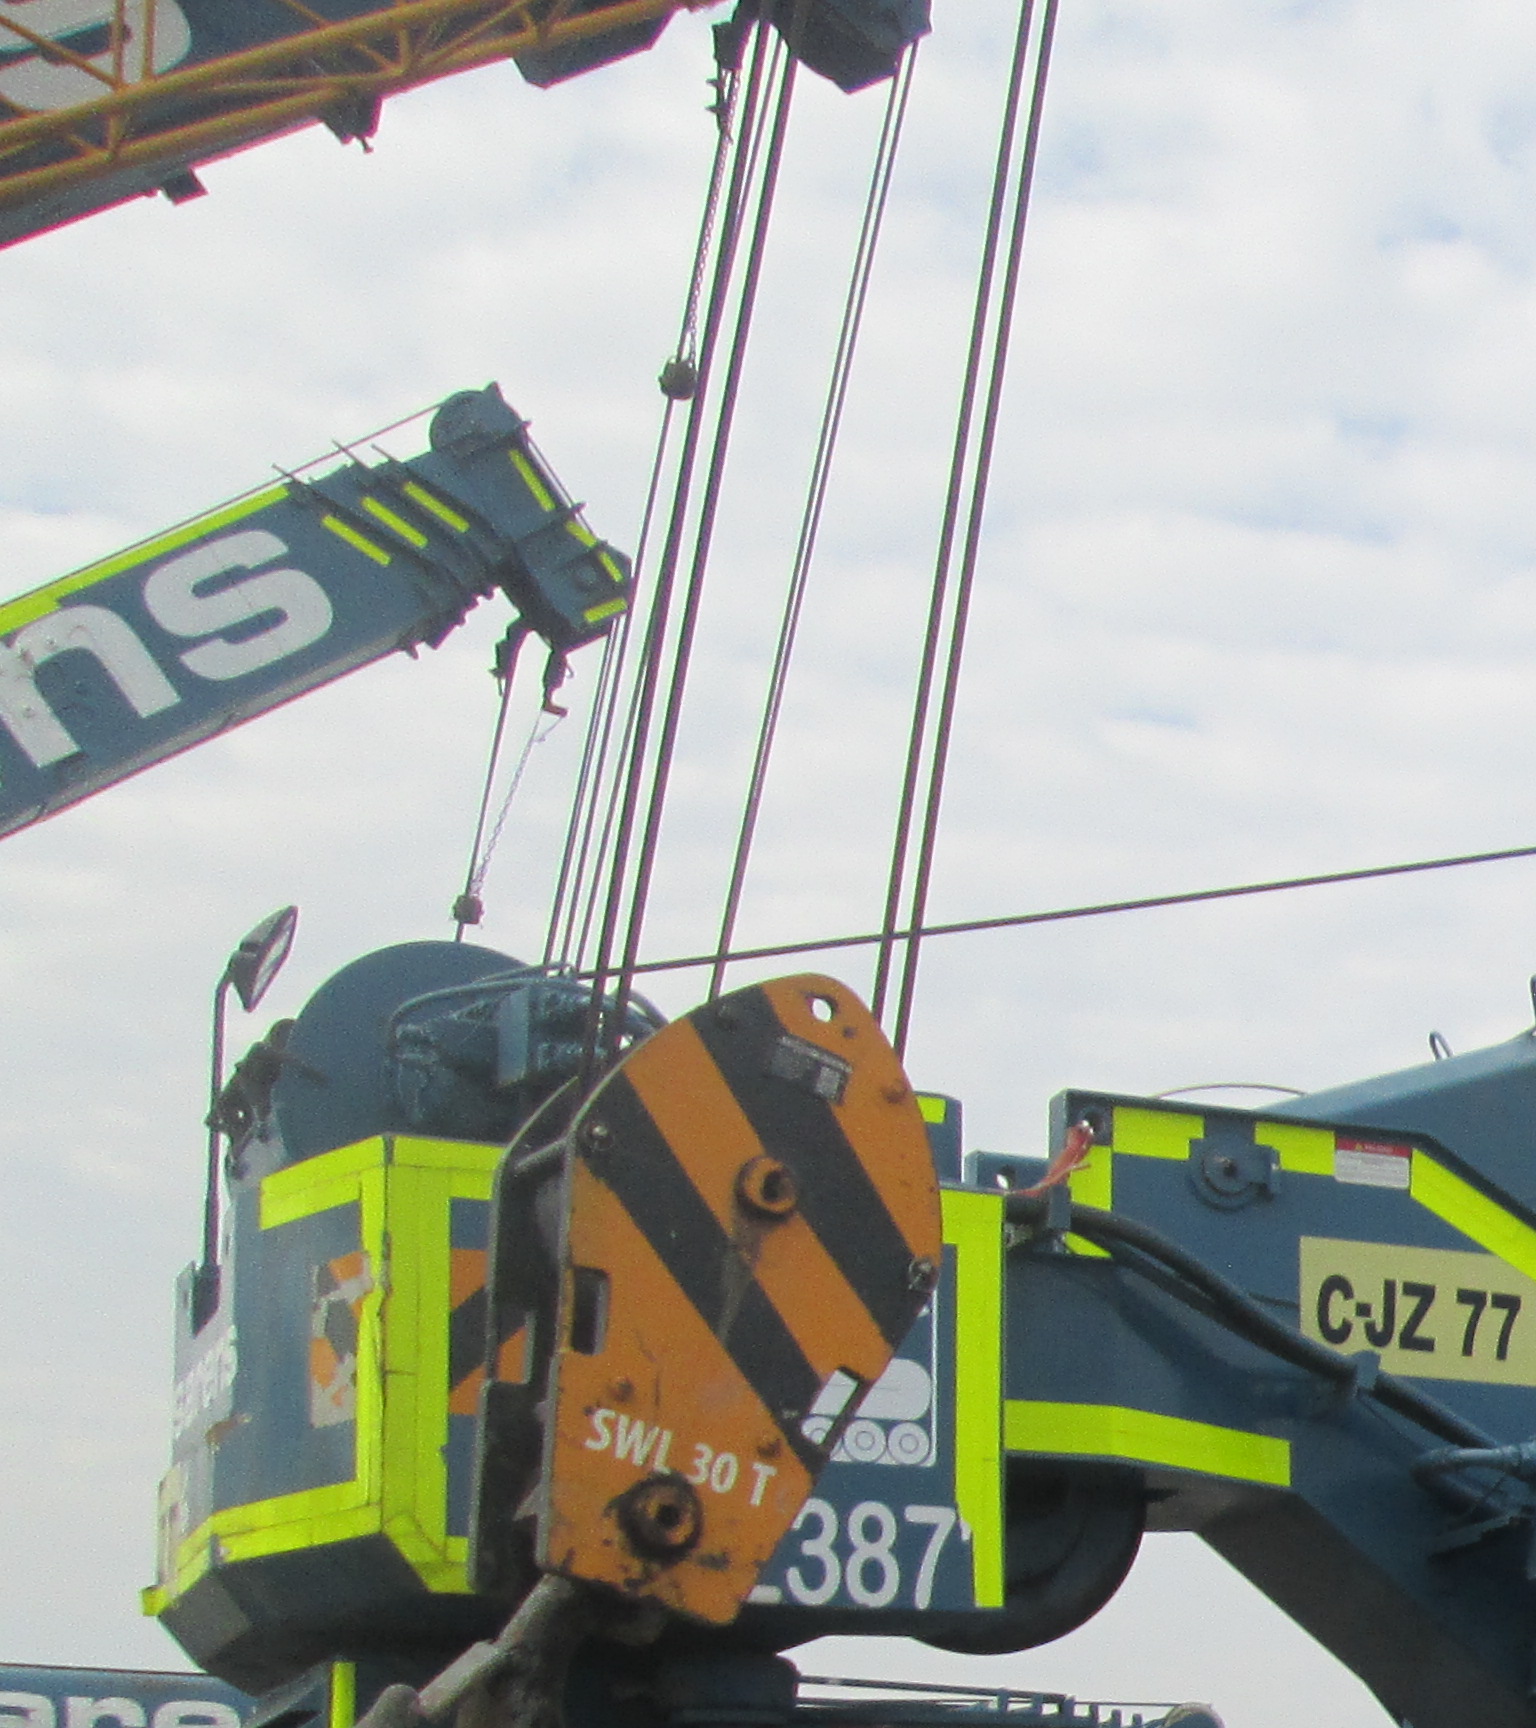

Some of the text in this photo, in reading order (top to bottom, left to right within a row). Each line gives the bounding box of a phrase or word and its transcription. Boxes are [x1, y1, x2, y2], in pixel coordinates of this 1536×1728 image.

[1456, 1288, 1522, 1361] 77
[585, 1408, 778, 1507] SWL 30 T
[747, 1497, 957, 1609] 387
